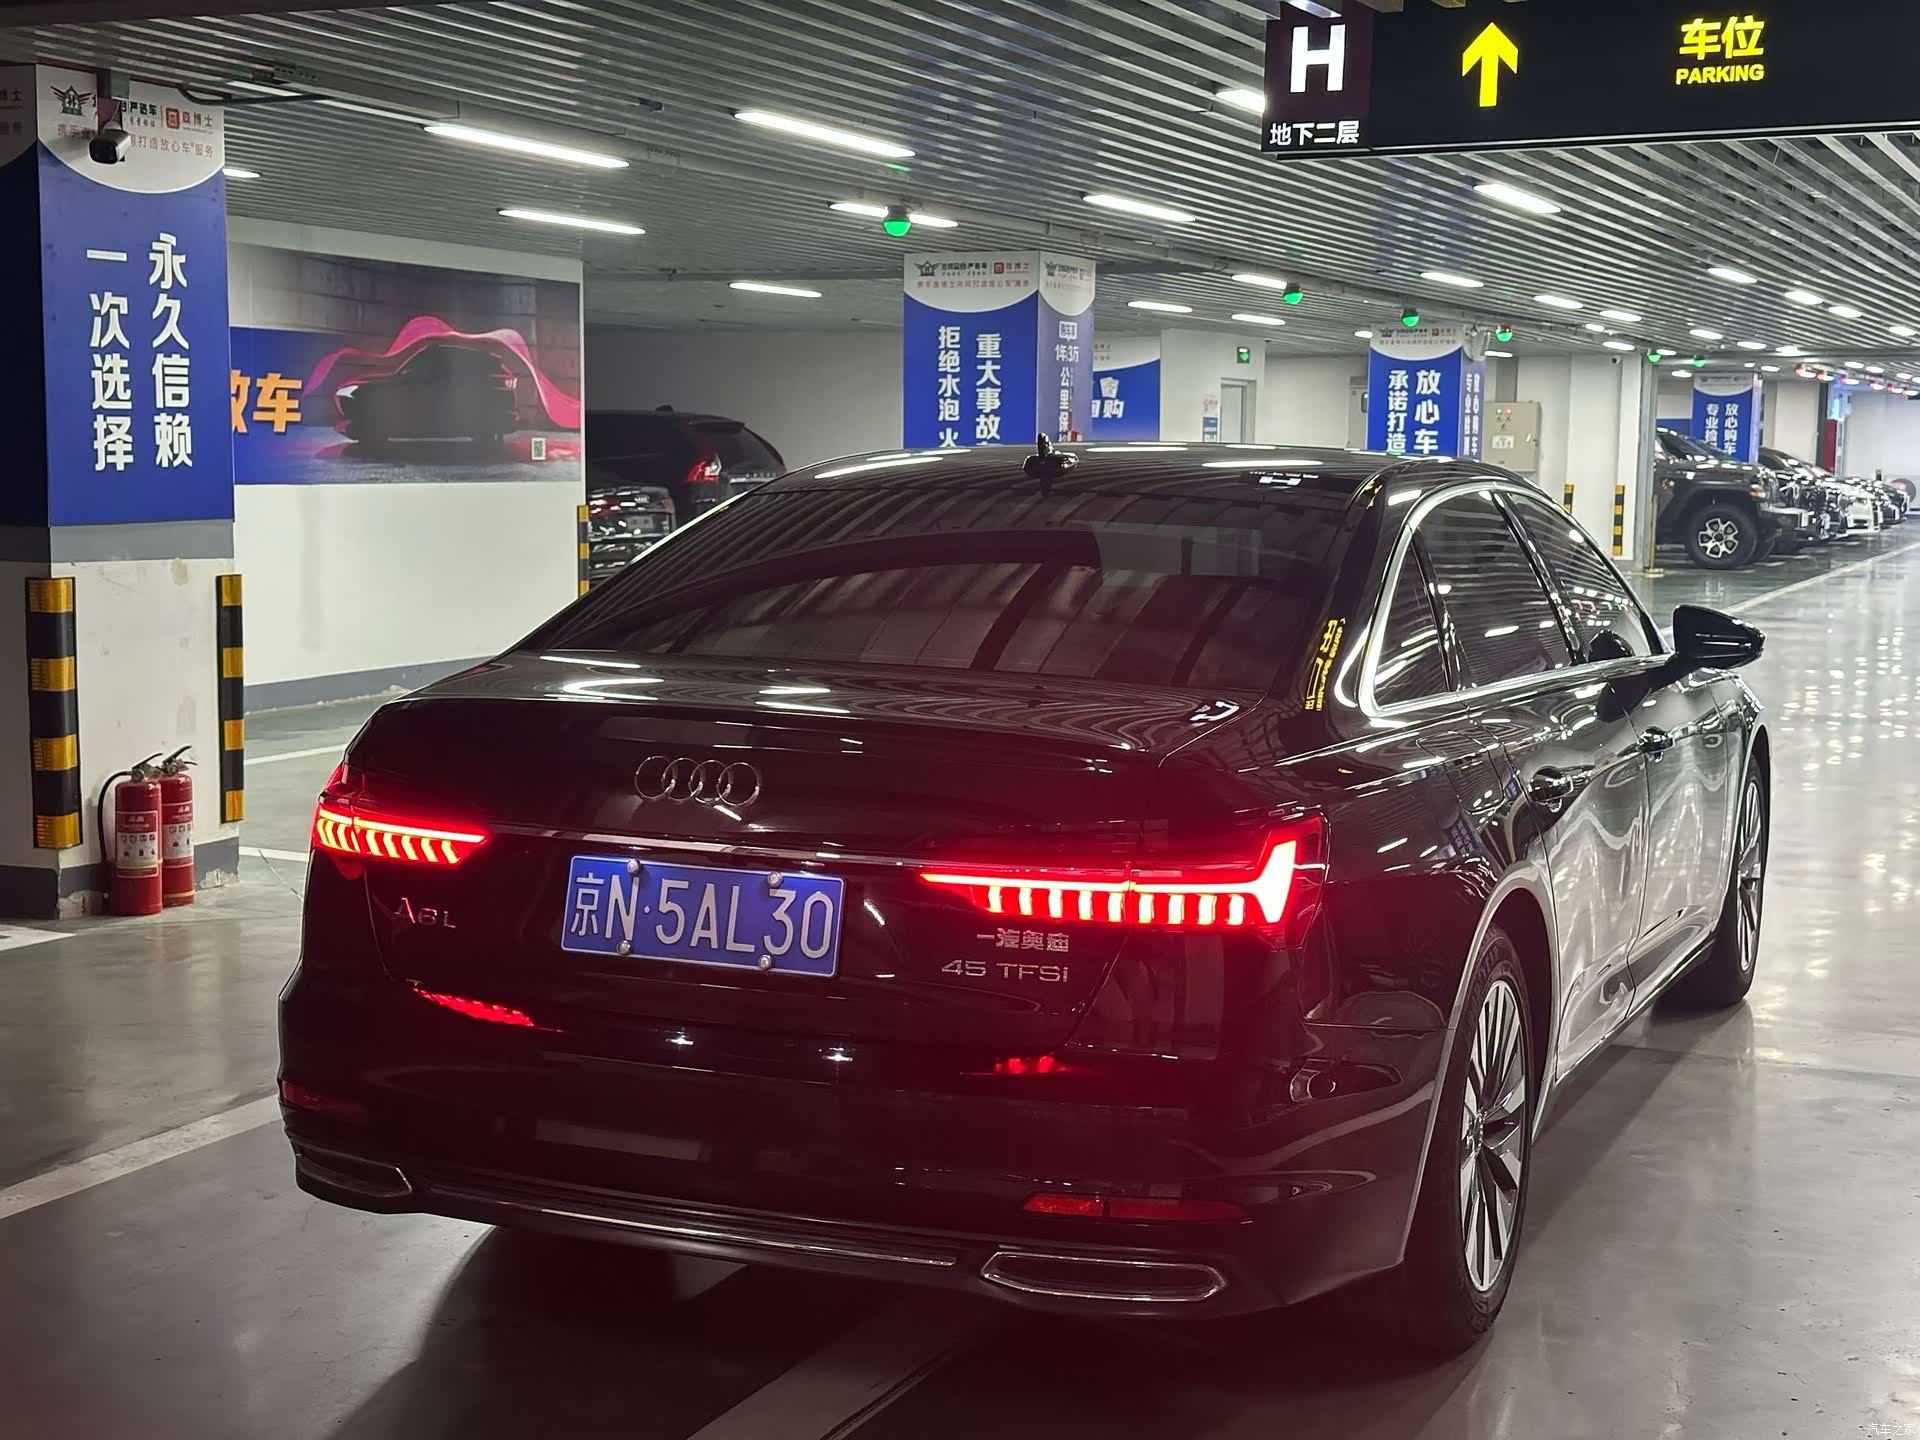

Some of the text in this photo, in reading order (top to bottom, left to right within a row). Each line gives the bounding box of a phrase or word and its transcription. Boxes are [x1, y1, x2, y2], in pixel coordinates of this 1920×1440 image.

[1290, 24, 1346, 93] H
[1679, 14, 1764, 60] 车位
[1675, 63, 1764, 85] PARKING
[1269, 120, 1359, 145] 地下二层
[86, 249, 134, 471] 一次选择
[149, 232, 193, 468] 永久信赖
[976, 333, 1002, 445] 重大事故
[1386, 370, 1408, 454] 承诺打造
[1414, 370, 1441, 454] 放心车
[1724, 403, 1739, 455] 放心购车
[570, 872, 834, 959] 京N·5AL30
[976, 928, 1070, 952] 一汽奥迪
[941, 959, 987, 977] 45
